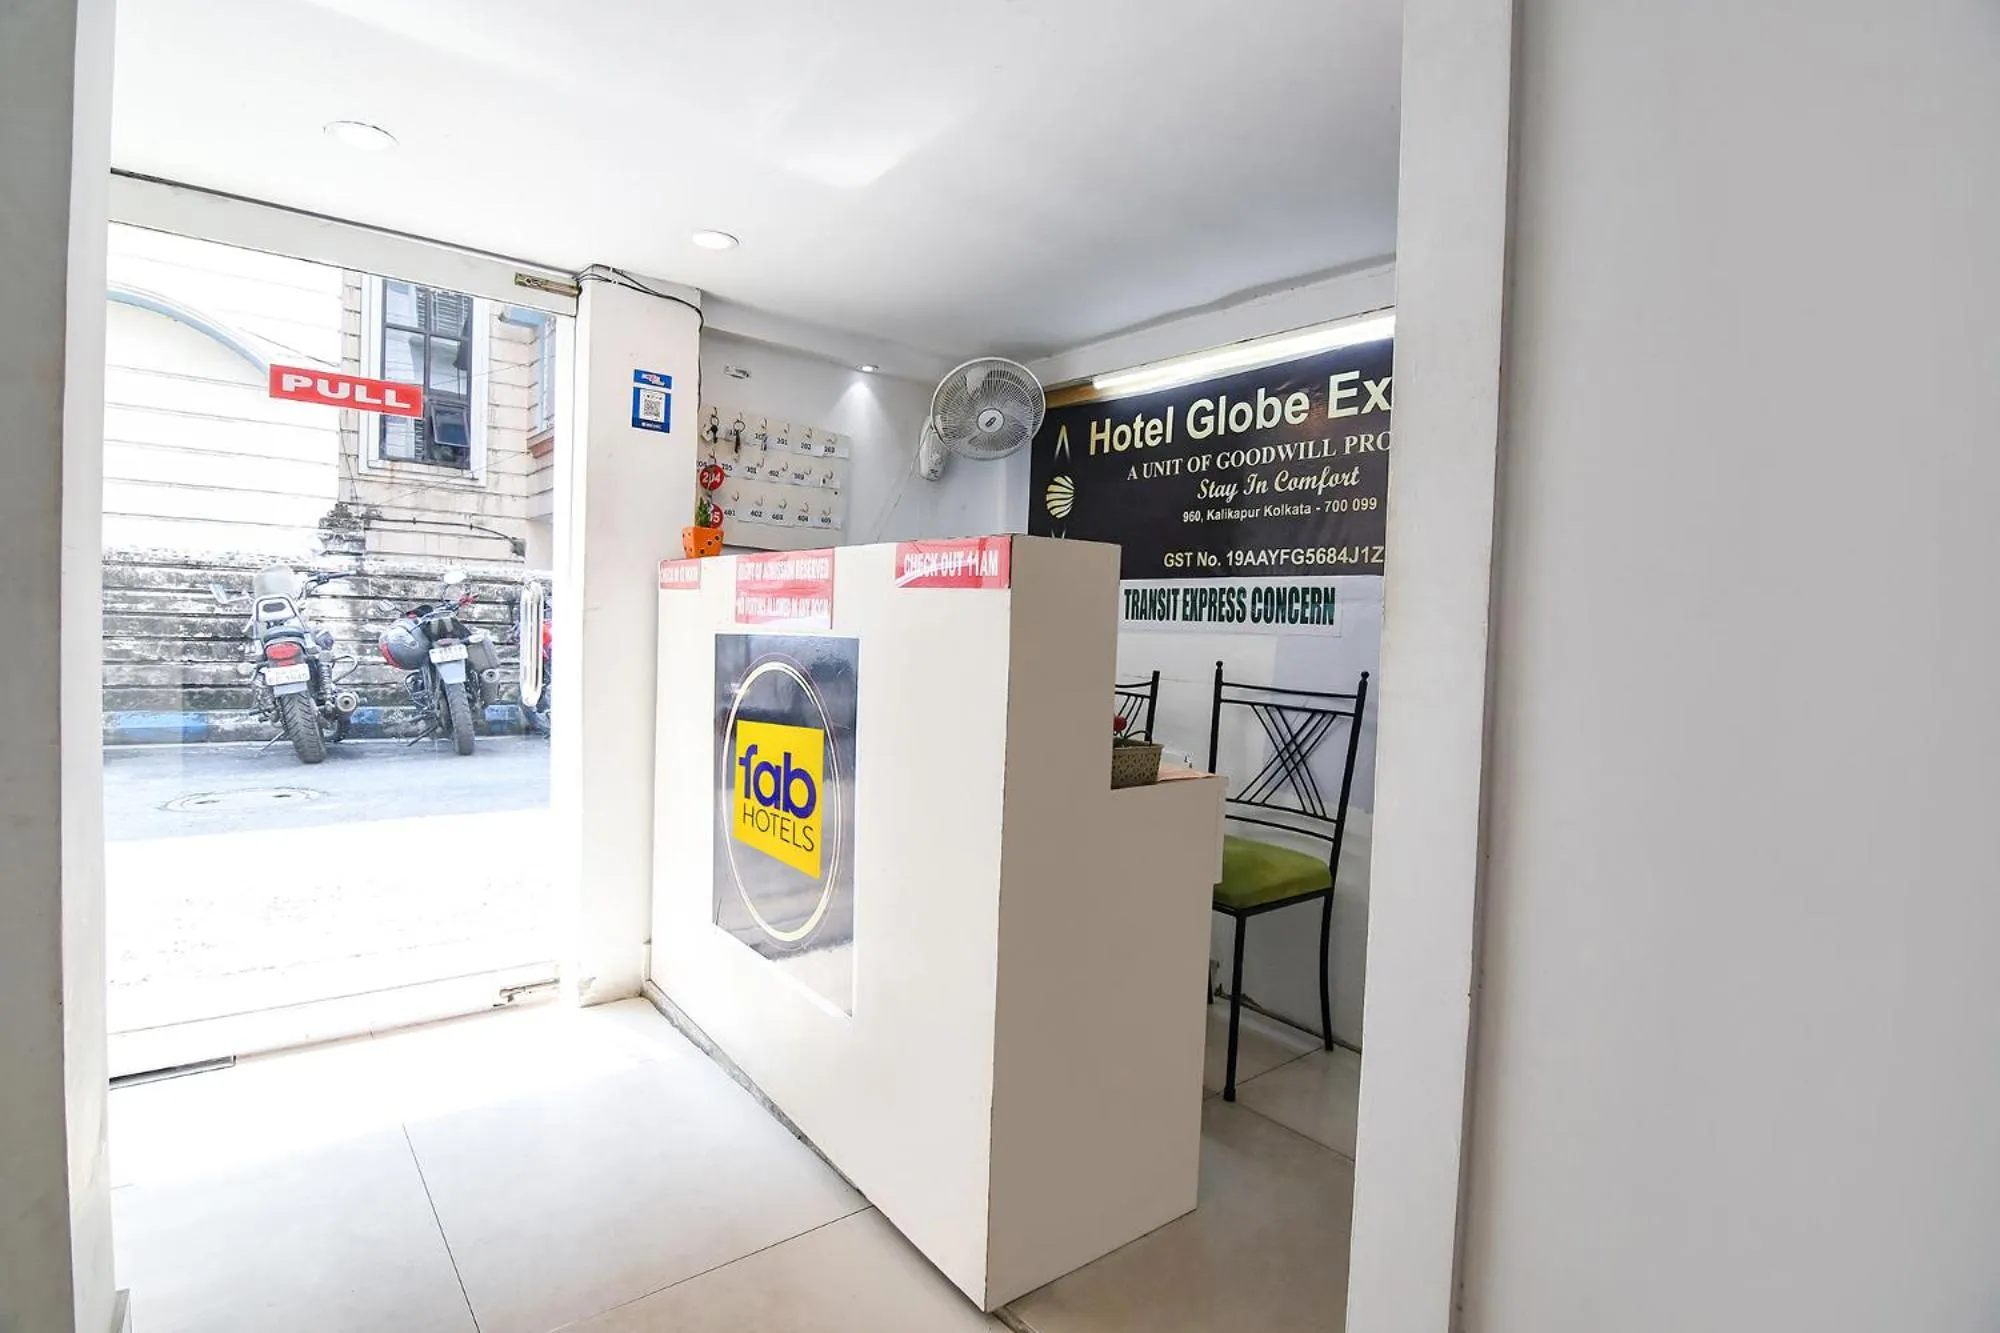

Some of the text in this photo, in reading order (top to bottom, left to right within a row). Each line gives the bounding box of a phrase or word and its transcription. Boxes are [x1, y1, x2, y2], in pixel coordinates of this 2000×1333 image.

[282, 373, 411, 409] PULL
[1090, 370, 1392, 455] Hotel Globe Ex
[1127, 465, 1138, 480] A
[1143, 458, 1183, 479] UNIT
[1187, 454, 1212, 473] OF
[1217, 438, 1337, 470] GOODWILL
[1197, 465, 1360, 504] Stay In Comfort
[1183, 511, 1203, 523] 960,
[1207, 507, 1260, 521] Kalikapur
[1264, 503, 1312, 517] Kolkata
[1324, 499, 1348, 513] 700
[1352, 497, 1377, 511] 099
[903, 553, 939, 577] CHECK
[940, 551, 964, 576] OUT
[1164, 545, 1385, 568] GST No. 19AAYFG5684J1Z
[1124, 586, 1335, 625] TRANSIT EXPRESS CONCERN
[739, 744, 816, 852] fab HOTELS
